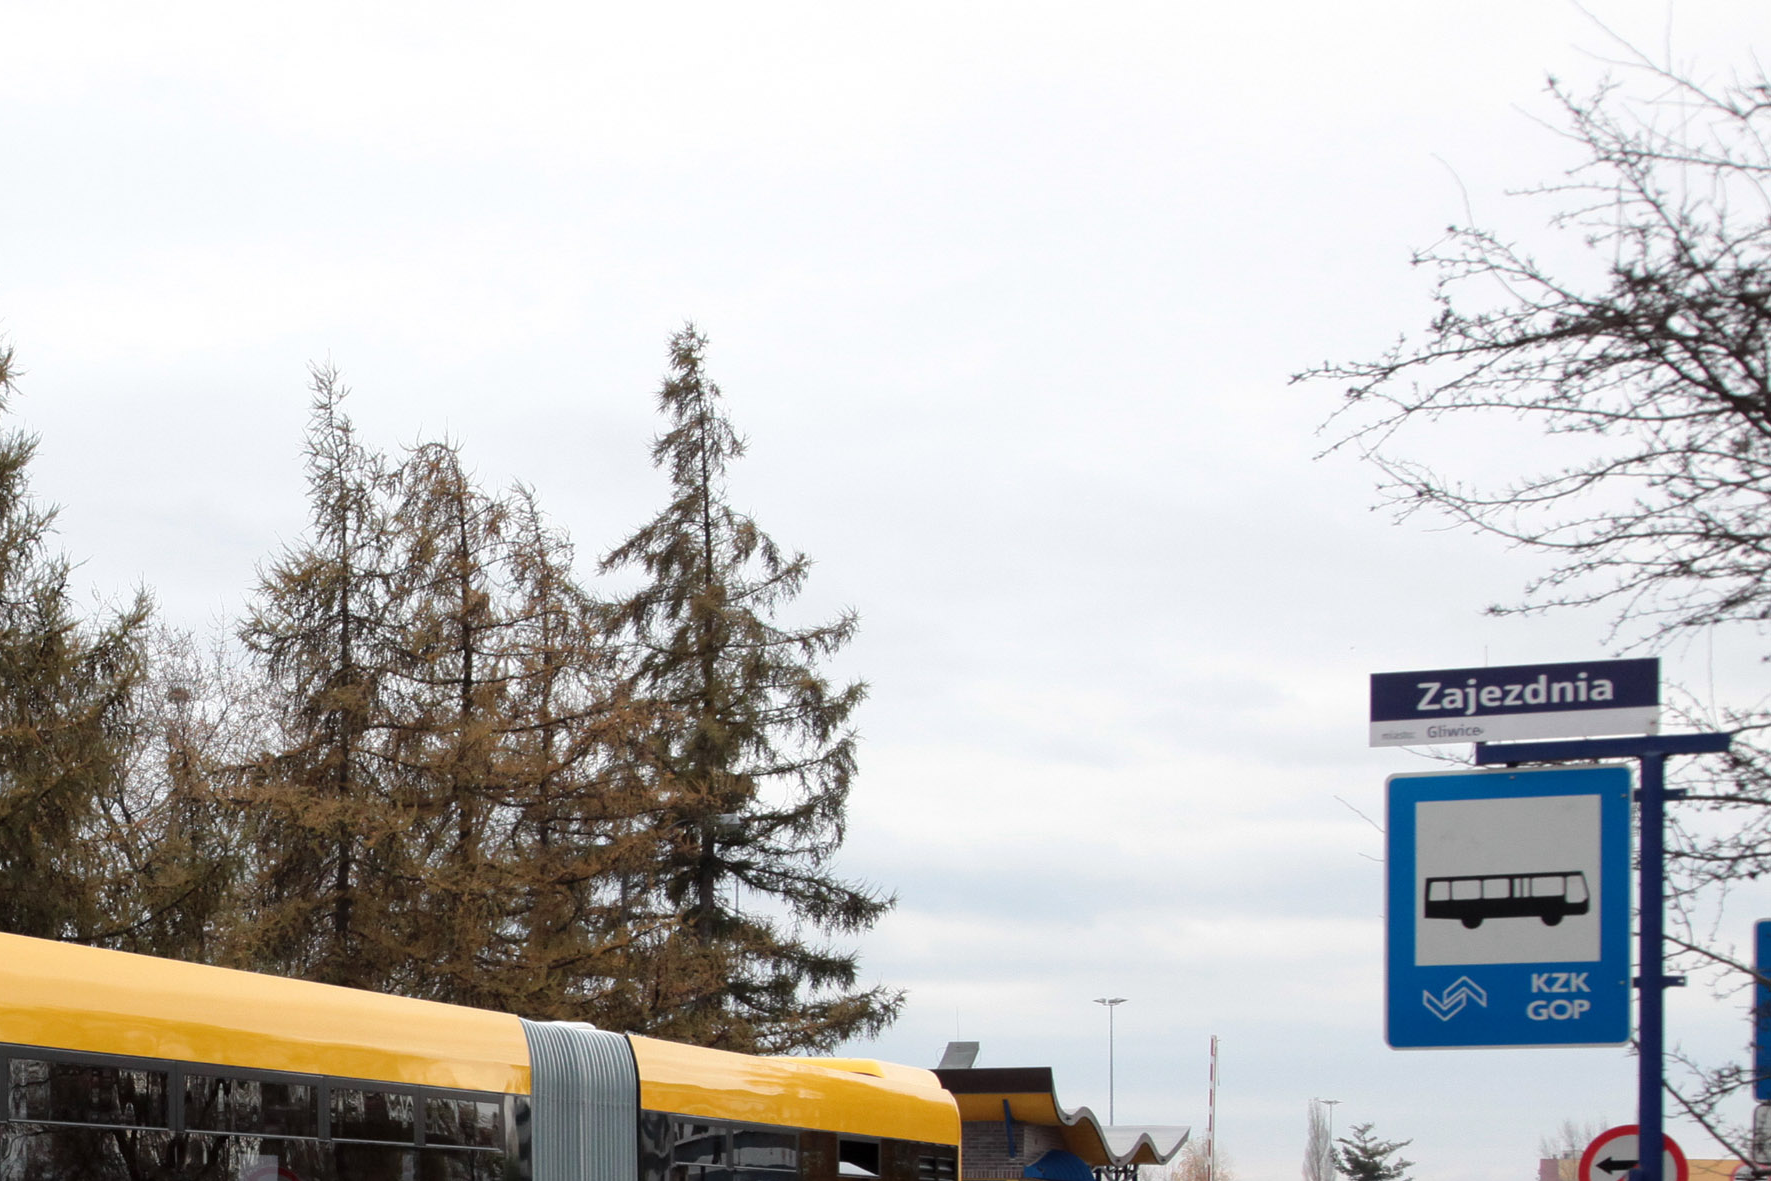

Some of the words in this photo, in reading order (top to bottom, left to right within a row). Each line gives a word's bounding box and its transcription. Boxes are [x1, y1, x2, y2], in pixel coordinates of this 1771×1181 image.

[1416, 672, 1614, 716] Zajezdnia
[1531, 972, 1591, 993] KZK
[1526, 999, 1591, 1021] GOP
